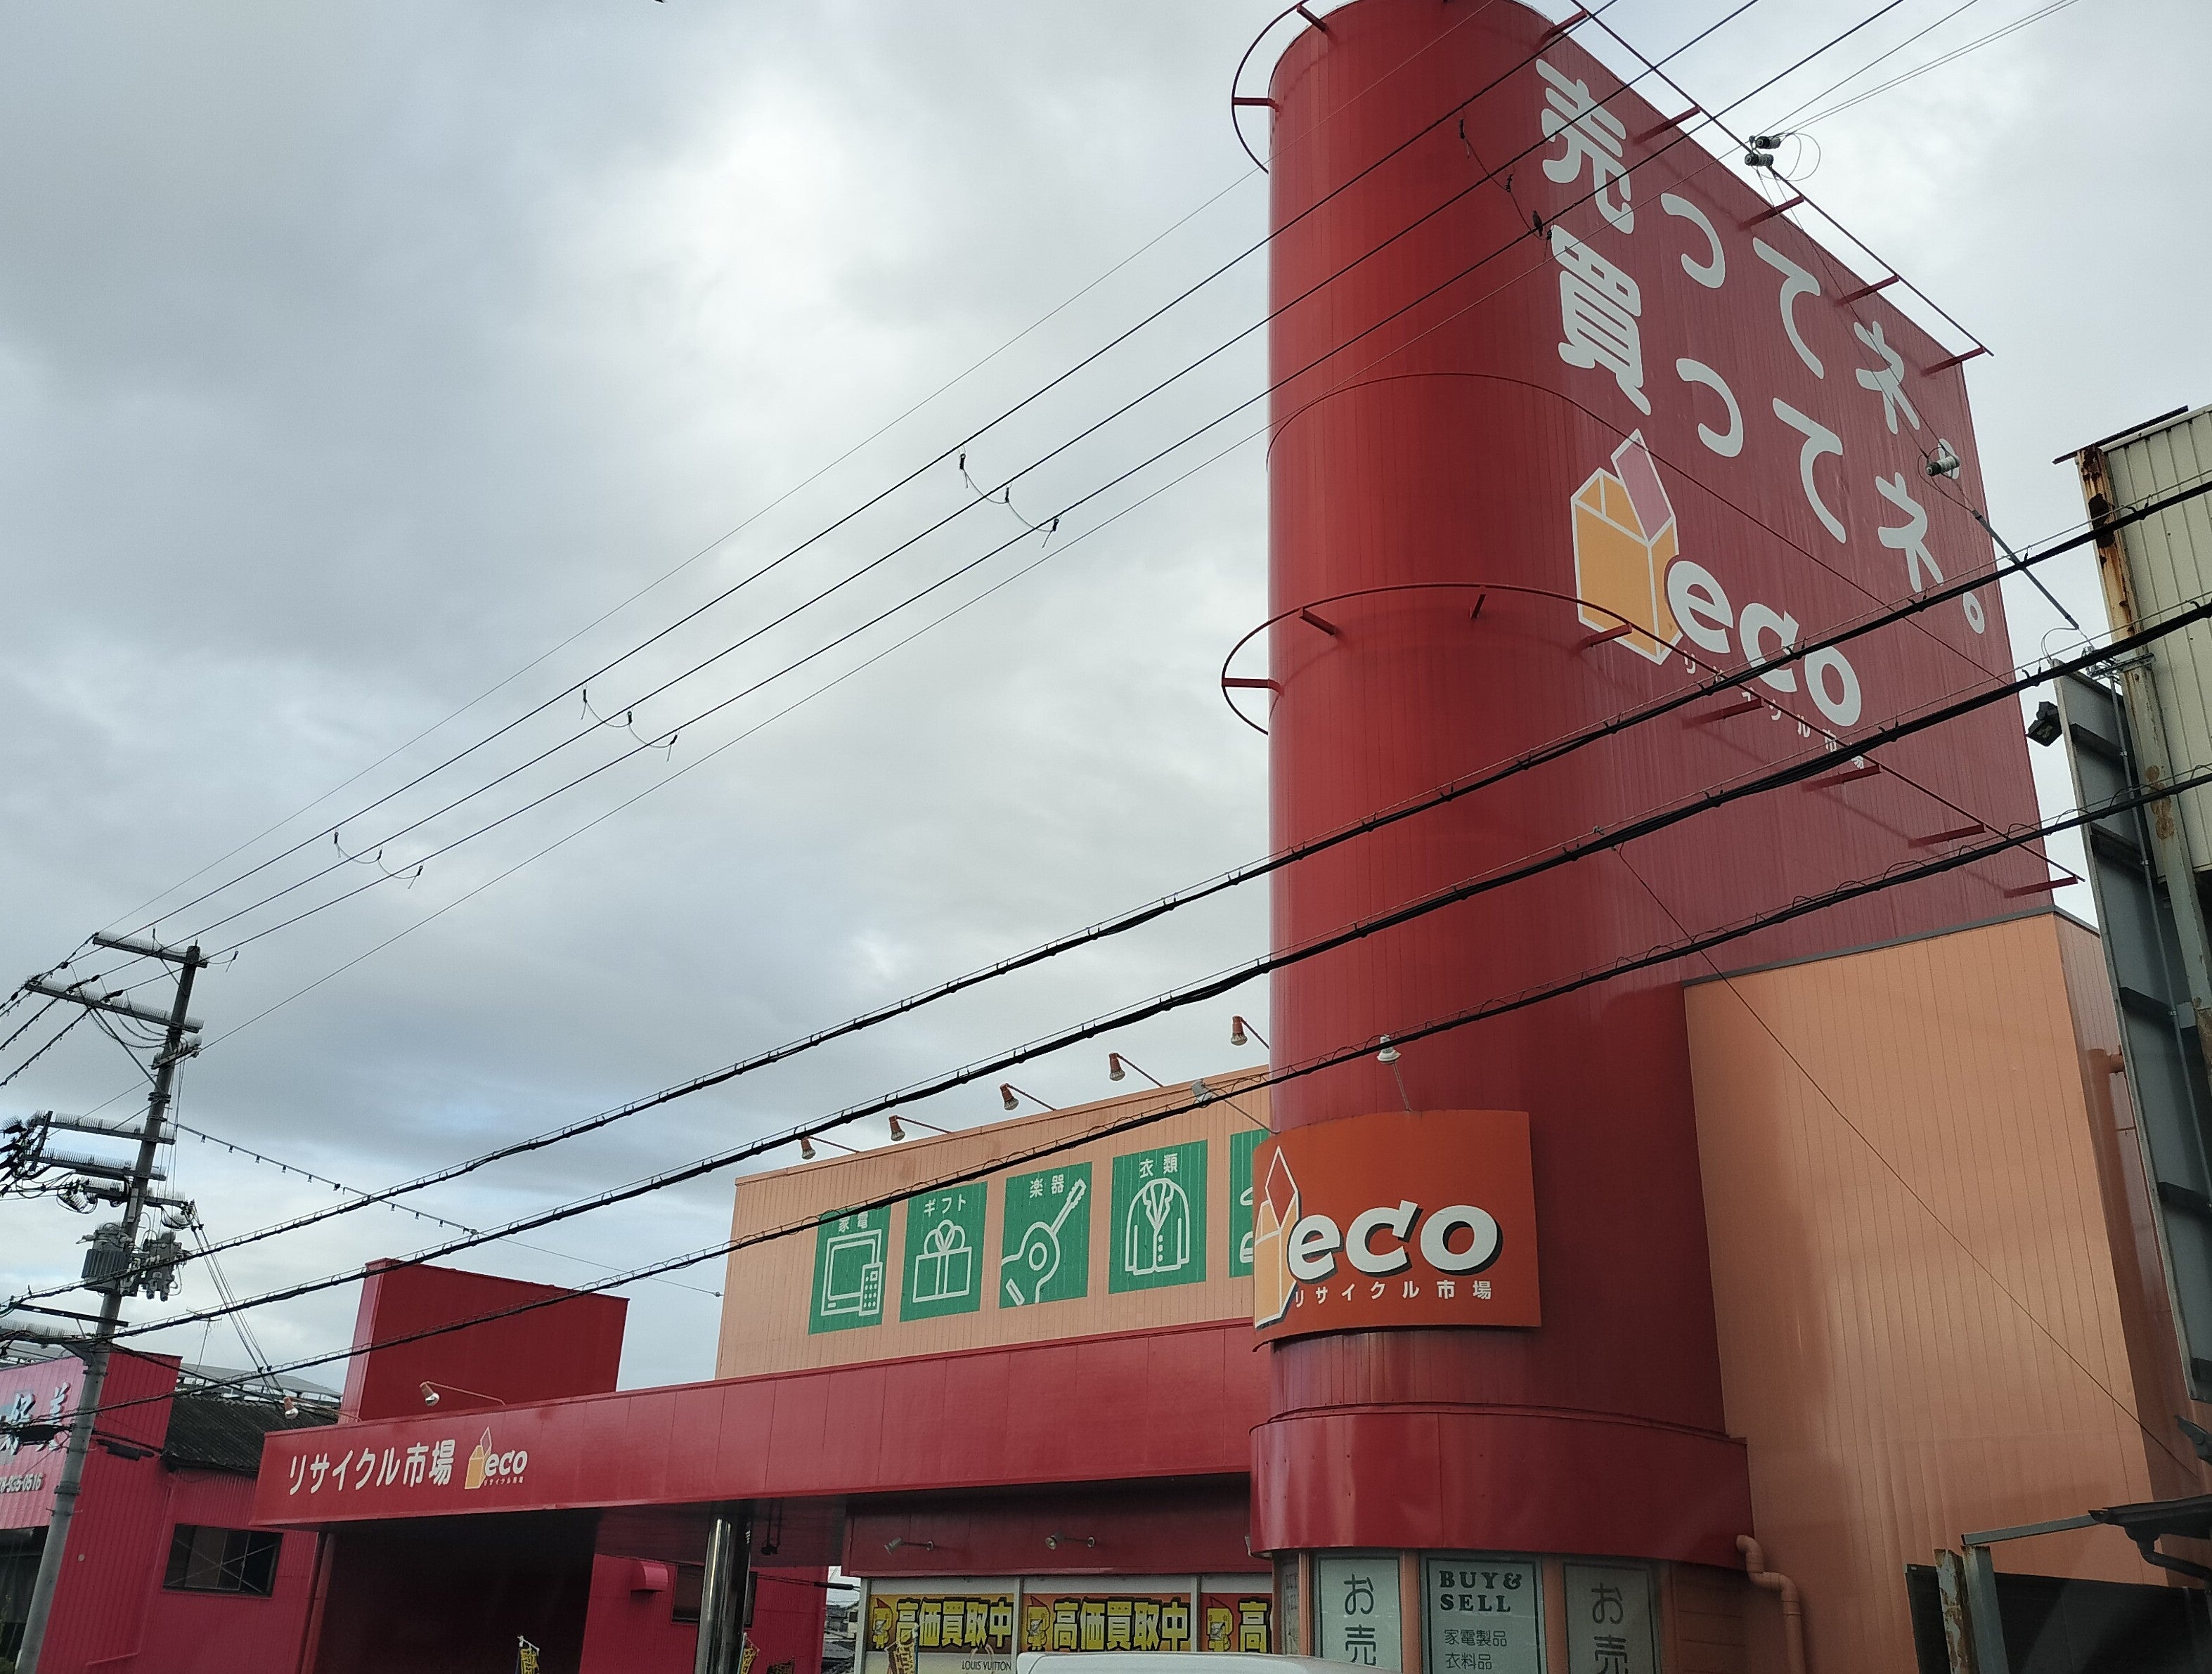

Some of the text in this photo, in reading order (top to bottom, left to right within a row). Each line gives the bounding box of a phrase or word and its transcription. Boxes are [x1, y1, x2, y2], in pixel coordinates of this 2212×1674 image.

[1667, 559, 1862, 727] eco
[1138, 1152, 1179, 1179] 衣類
[1029, 1174, 1065, 1199] 楽器
[923, 1193, 967, 1217] ギフト
[838, 1211, 869, 1233] 家電
[1288, 1199, 1503, 1282] eco
[1294, 1279, 1492, 1309] リサイクル市場
[289, 1439, 456, 1495] リサイクル市場
[484, 1449, 529, 1477] eco
[1440, 1593, 1511, 1613] SELL
[896, 1600, 1013, 1649] 高価買取中
[1054, 1597, 1192, 1652] 高価買取中
[1444, 1628, 1508, 1647] 家電製品
[962, 1660, 1012, 1671] LOUIS VUITTON
[1444, 1652, 1493, 1670] 衣料品
